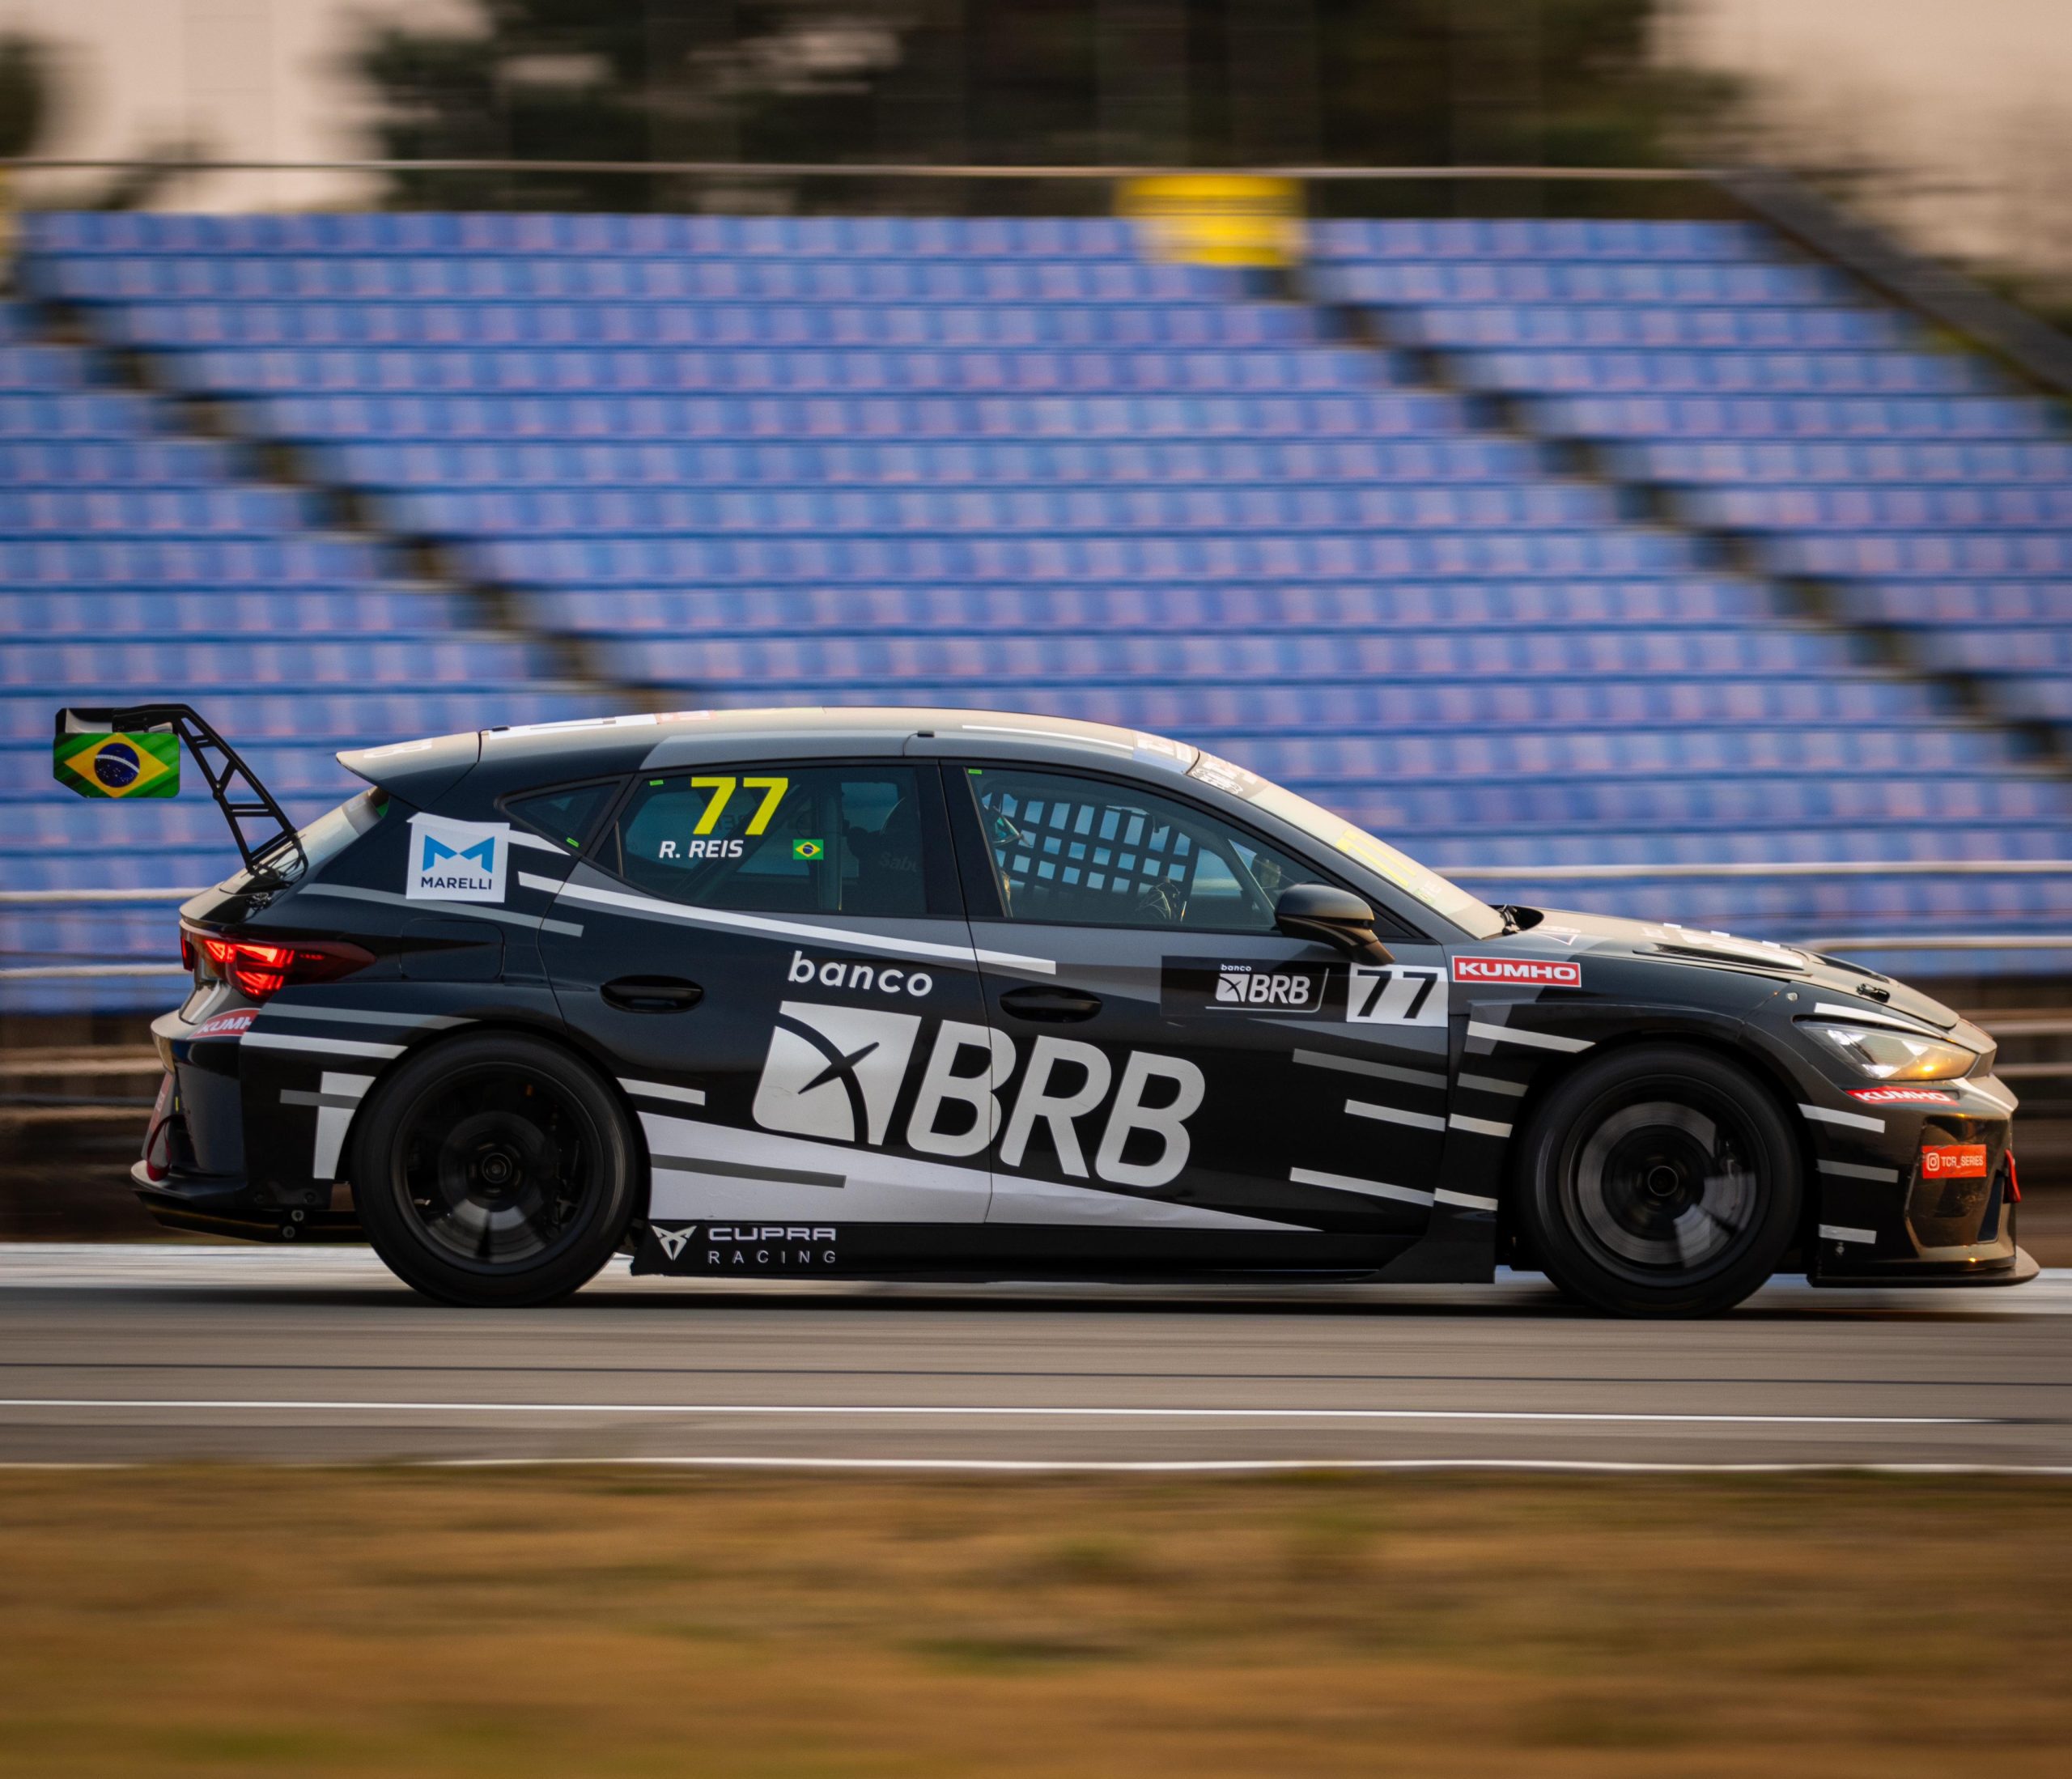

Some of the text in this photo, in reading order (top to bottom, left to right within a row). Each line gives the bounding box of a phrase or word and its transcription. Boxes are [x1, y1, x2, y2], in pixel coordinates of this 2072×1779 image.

[690, 776, 788, 835] 77
[659, 839, 745, 859] R. REIS
[421, 877, 492, 890] MARELLI
[788, 950, 933, 997] banco
[1221, 963, 1252, 972] banco
[1458, 961, 1577, 981] KUMHO
[1249, 974, 1311, 1004] BRB
[1357, 969, 1437, 1019] 77
[906, 1019, 1205, 1188] BRB
[1855, 1090, 1951, 1102] KUMHO
[1941, 1155, 1984, 1168] TCR_SERIES
[708, 1227, 836, 1241] CUPRA
[708, 1250, 836, 1264] RACING
